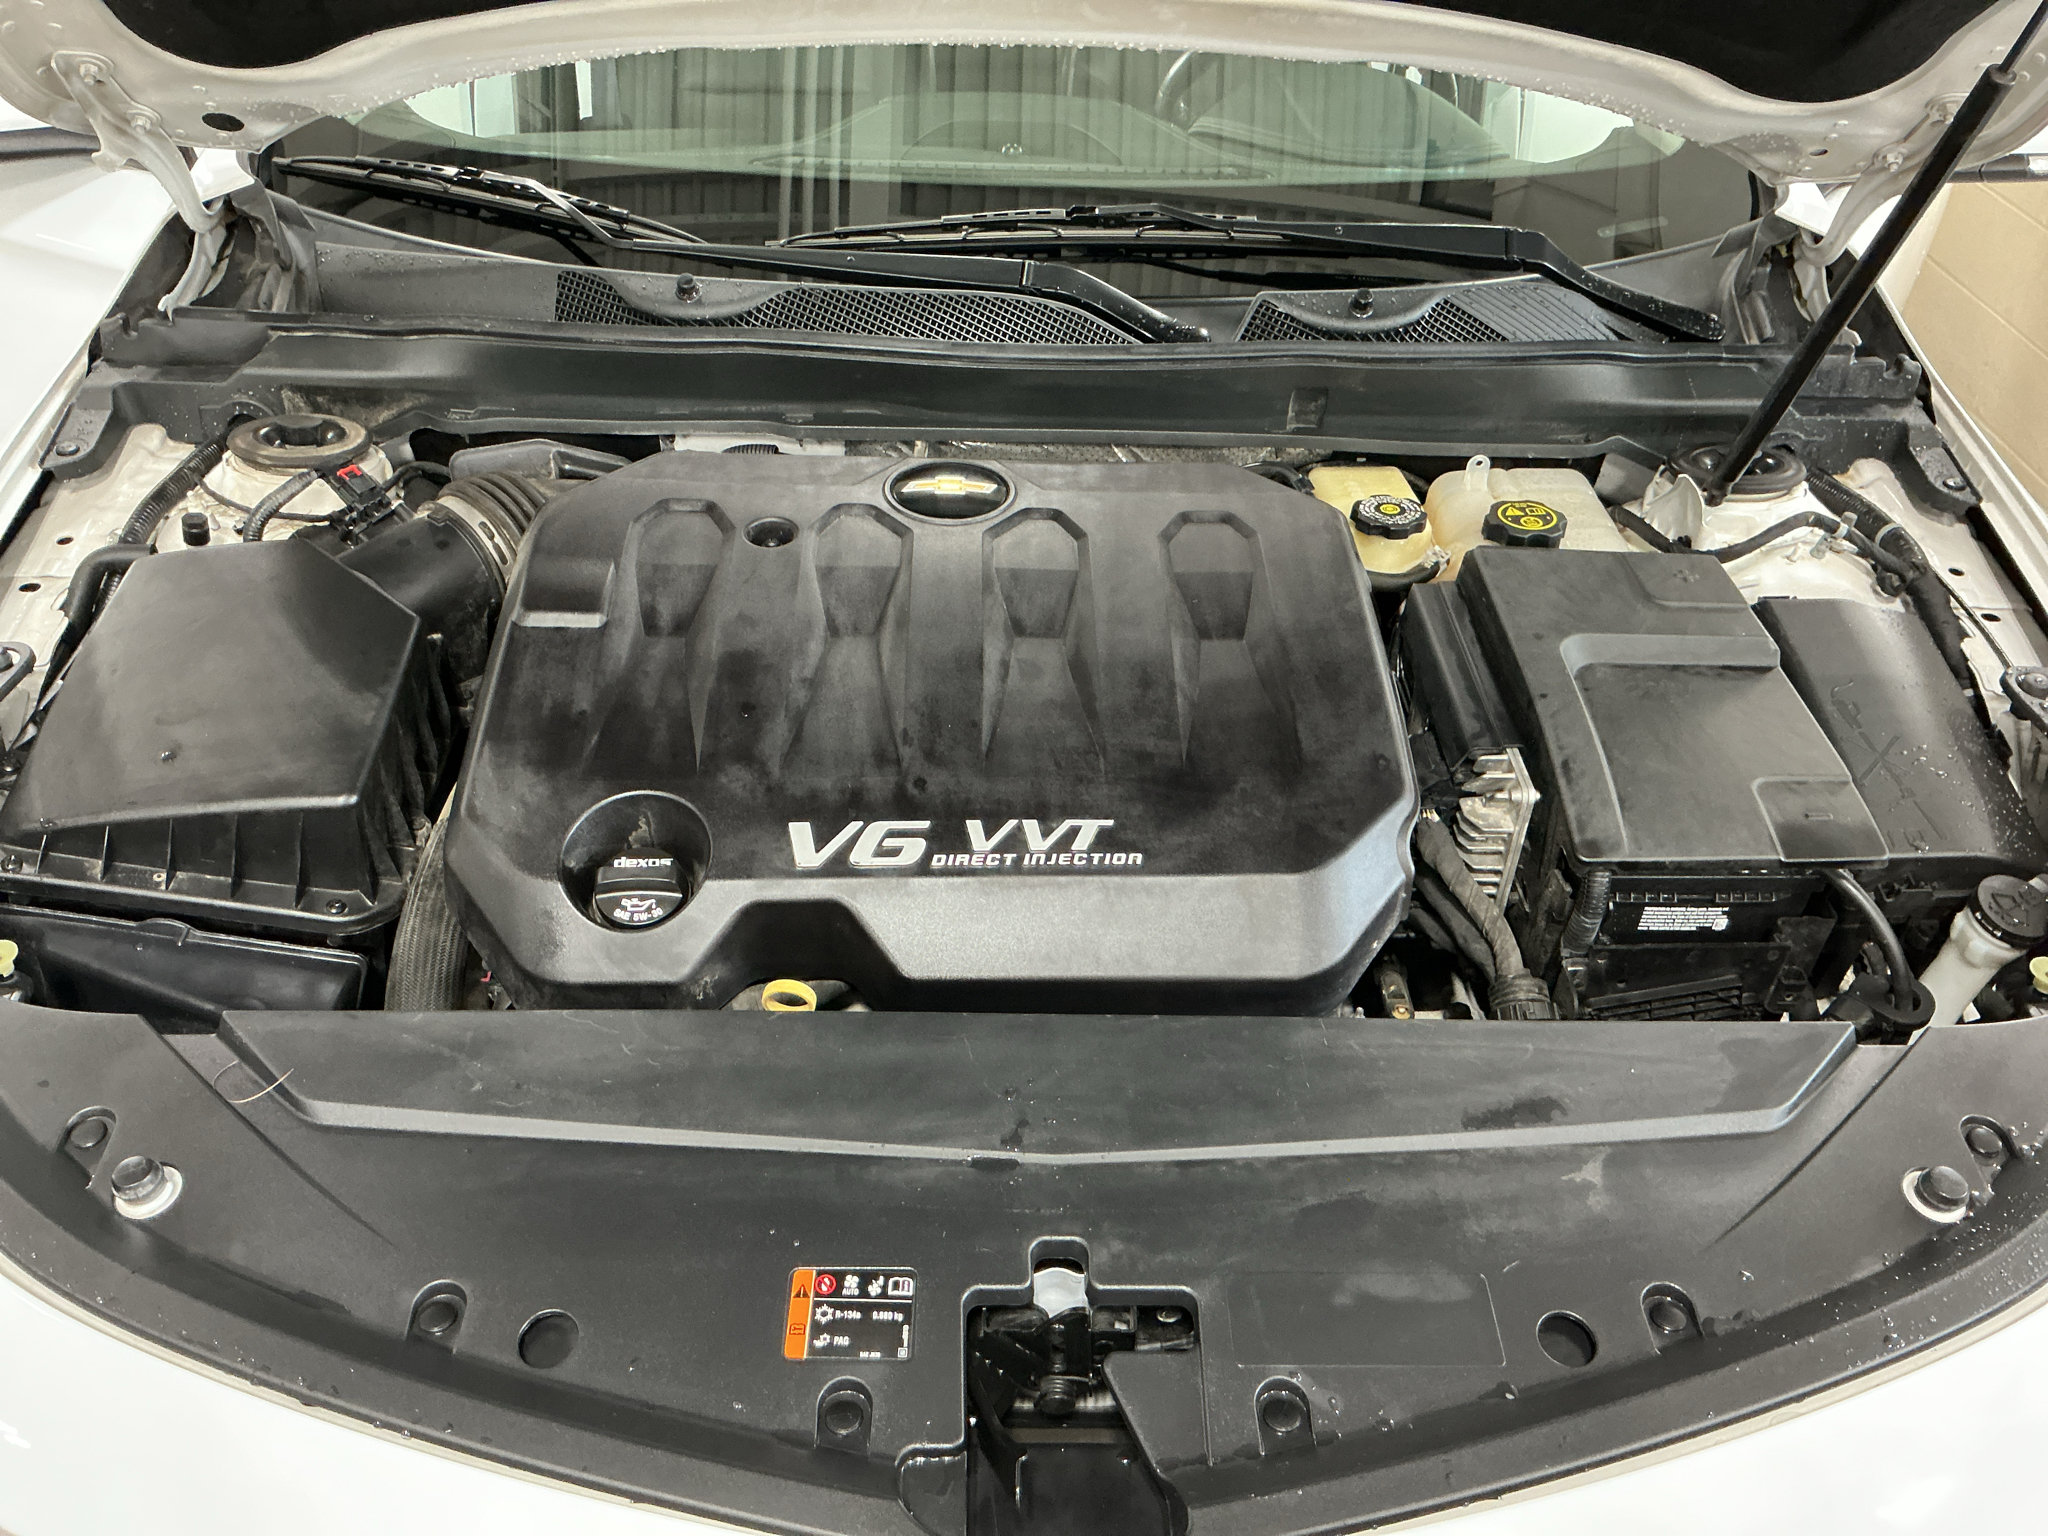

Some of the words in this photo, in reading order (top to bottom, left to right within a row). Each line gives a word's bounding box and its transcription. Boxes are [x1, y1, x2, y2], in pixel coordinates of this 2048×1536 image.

[788, 820, 931, 869] V6
[964, 818, 1115, 852] VVT
[613, 856, 674, 868] dexos
[930, 852, 1017, 867] DIRECT
[1022, 852, 1143, 867] INJECTION
[613, 908, 632, 921] SAE
[632, 907, 664, 921] 5W-30
[841, 1287, 860, 1297] AUTO
[834, 1309, 862, 1320] R-134a
[832, 1335, 851, 1347] PAG
